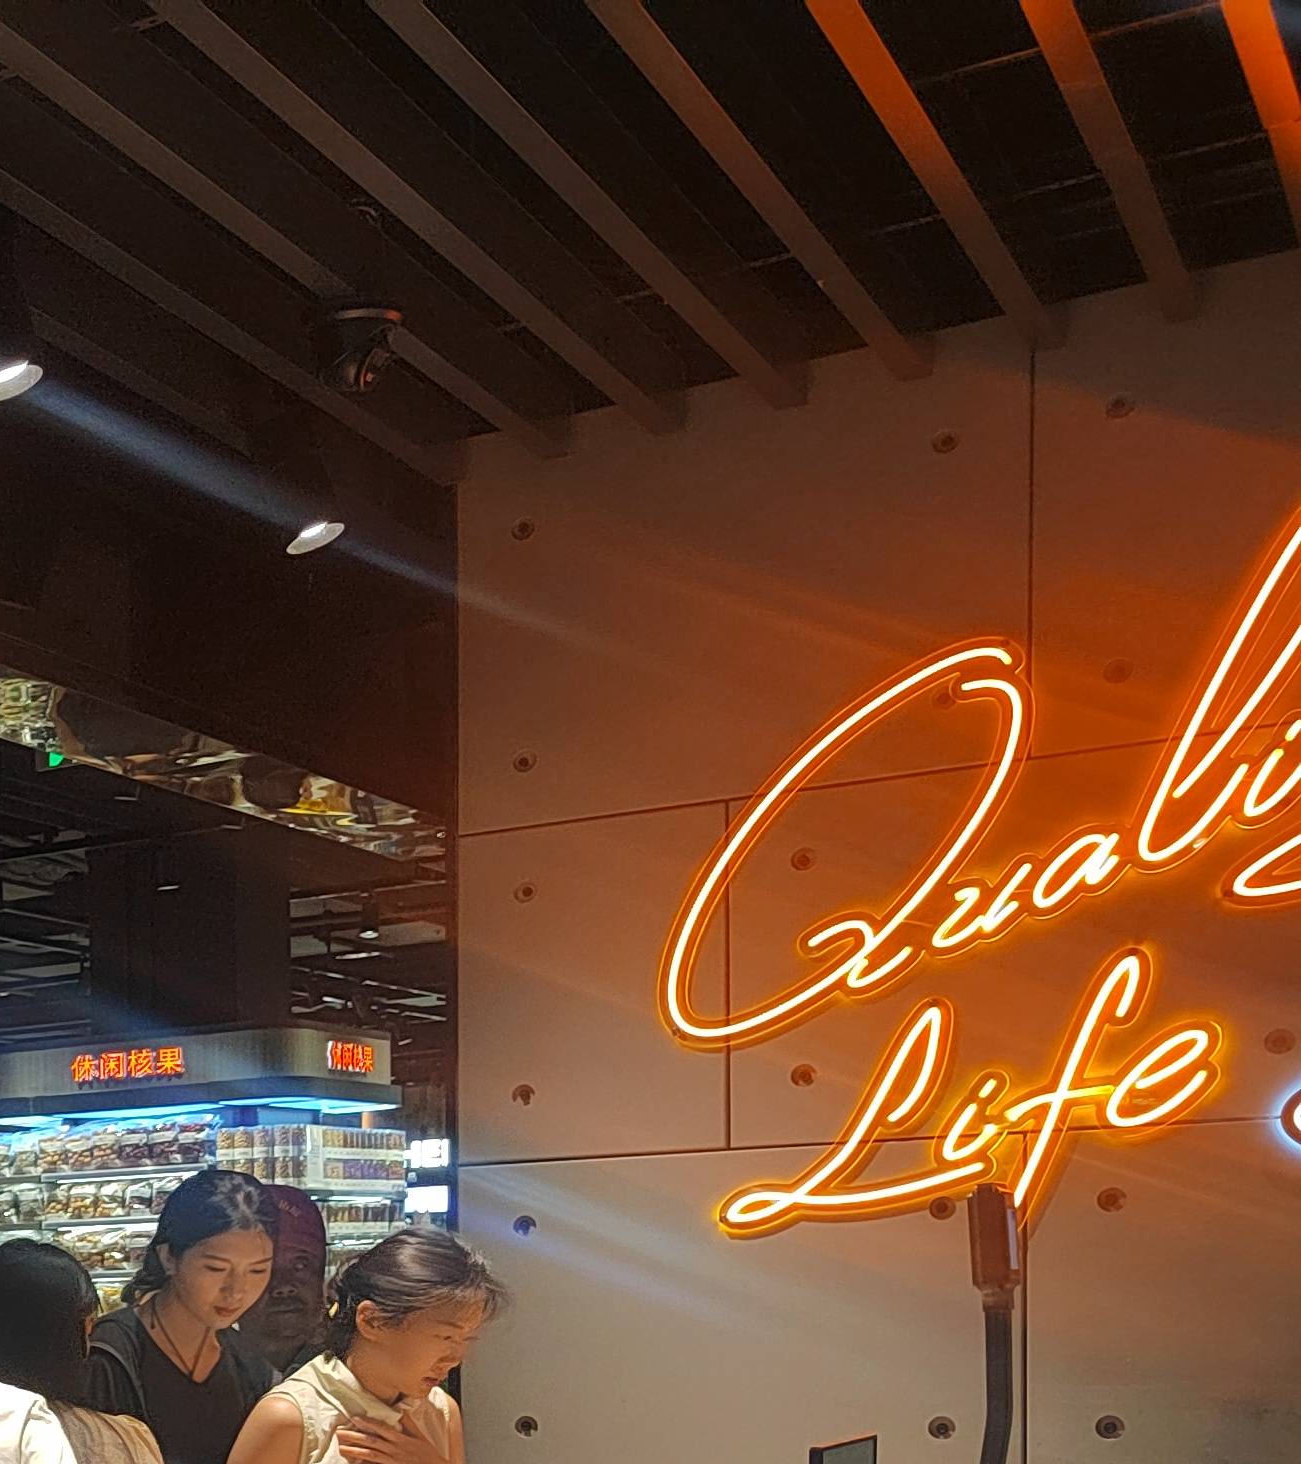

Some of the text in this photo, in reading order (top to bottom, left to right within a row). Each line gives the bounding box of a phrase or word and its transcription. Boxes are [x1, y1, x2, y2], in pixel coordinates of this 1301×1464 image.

[663, 526, 1301, 1040] Quali
[70, 1046, 185, 1082] 休闲核果
[723, 950, 1213, 1225] Life
